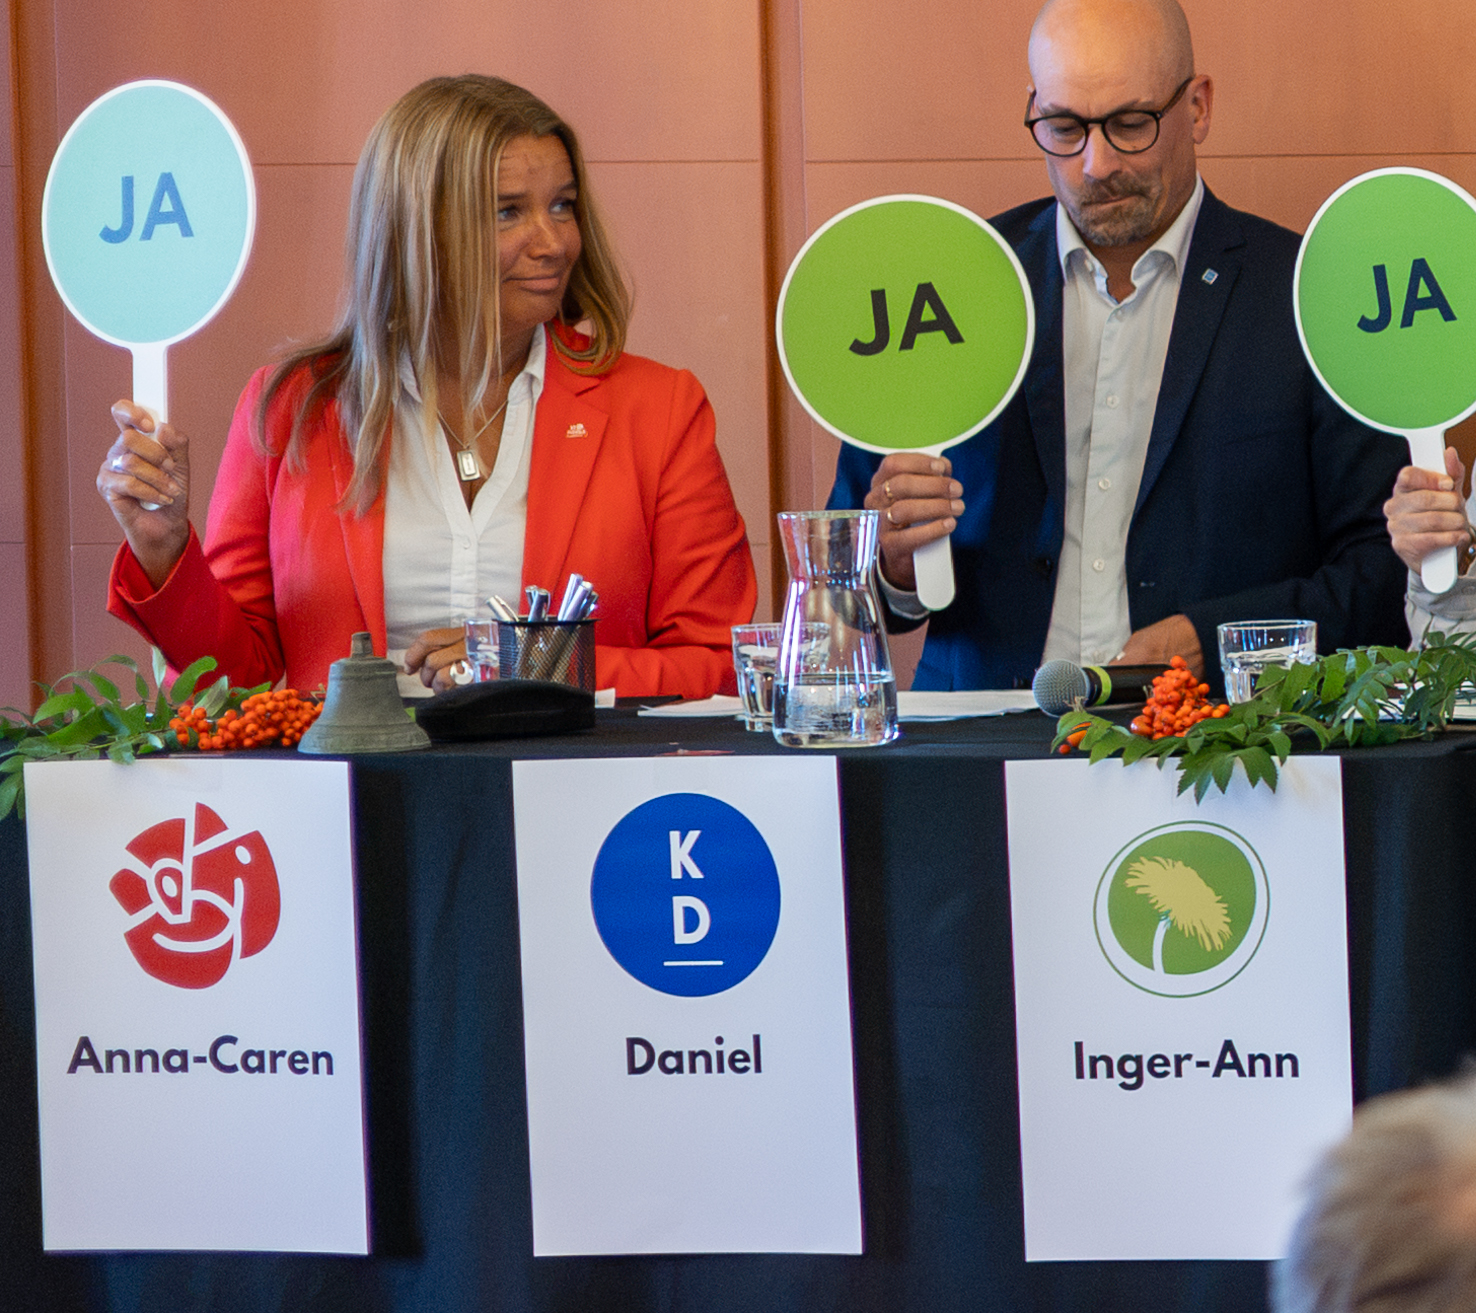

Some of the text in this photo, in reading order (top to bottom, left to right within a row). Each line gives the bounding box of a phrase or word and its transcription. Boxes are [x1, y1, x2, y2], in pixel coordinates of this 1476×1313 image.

[98, 171, 195, 245] JA
[848, 281, 965, 357] JA
[1356, 257, 1458, 334] JA
[66, 1034, 334, 1076] Anna-Caren
[625, 1033, 763, 1076] Daniel
[1074, 1039, 1300, 1091] Inger-Ann
